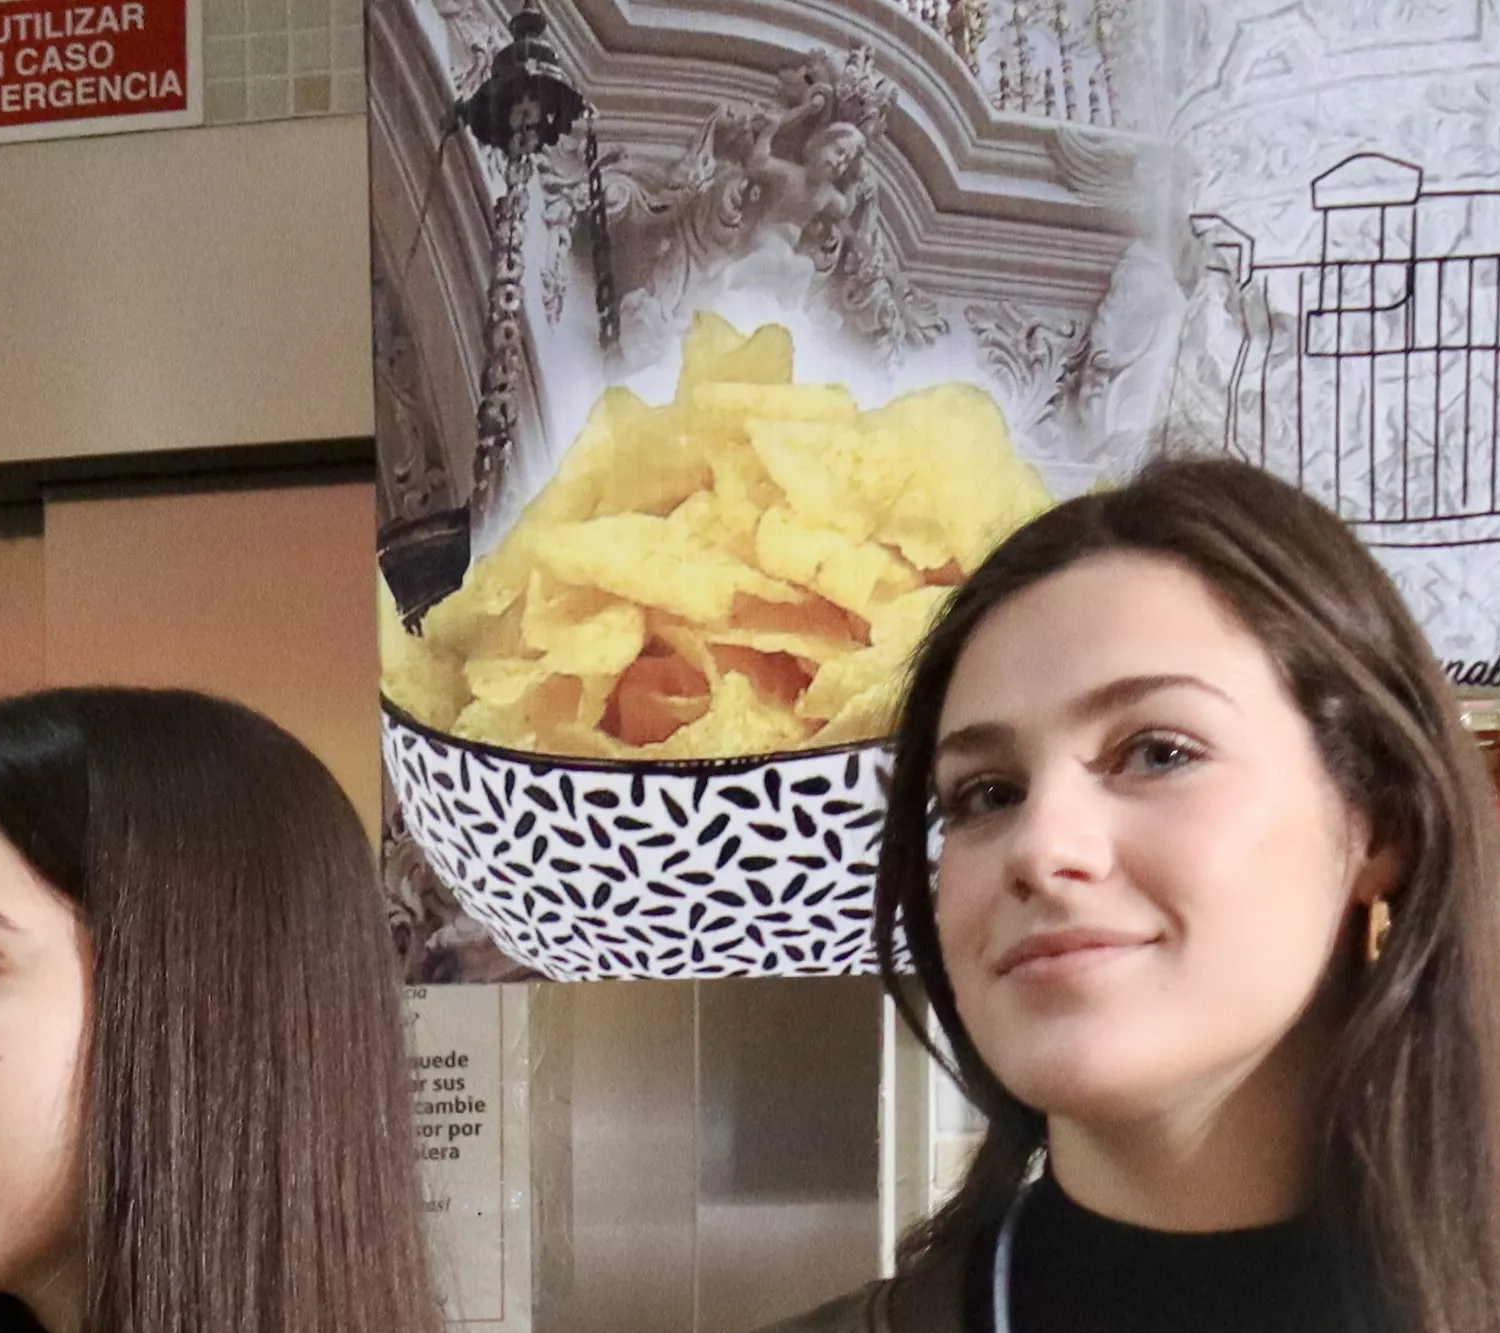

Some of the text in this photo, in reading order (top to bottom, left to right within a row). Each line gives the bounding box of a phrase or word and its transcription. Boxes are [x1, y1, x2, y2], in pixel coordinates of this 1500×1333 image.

[15, 41, 114, 77] CASO
[432, 1076, 465, 1092] sus
[448, 1121, 483, 1142] por
